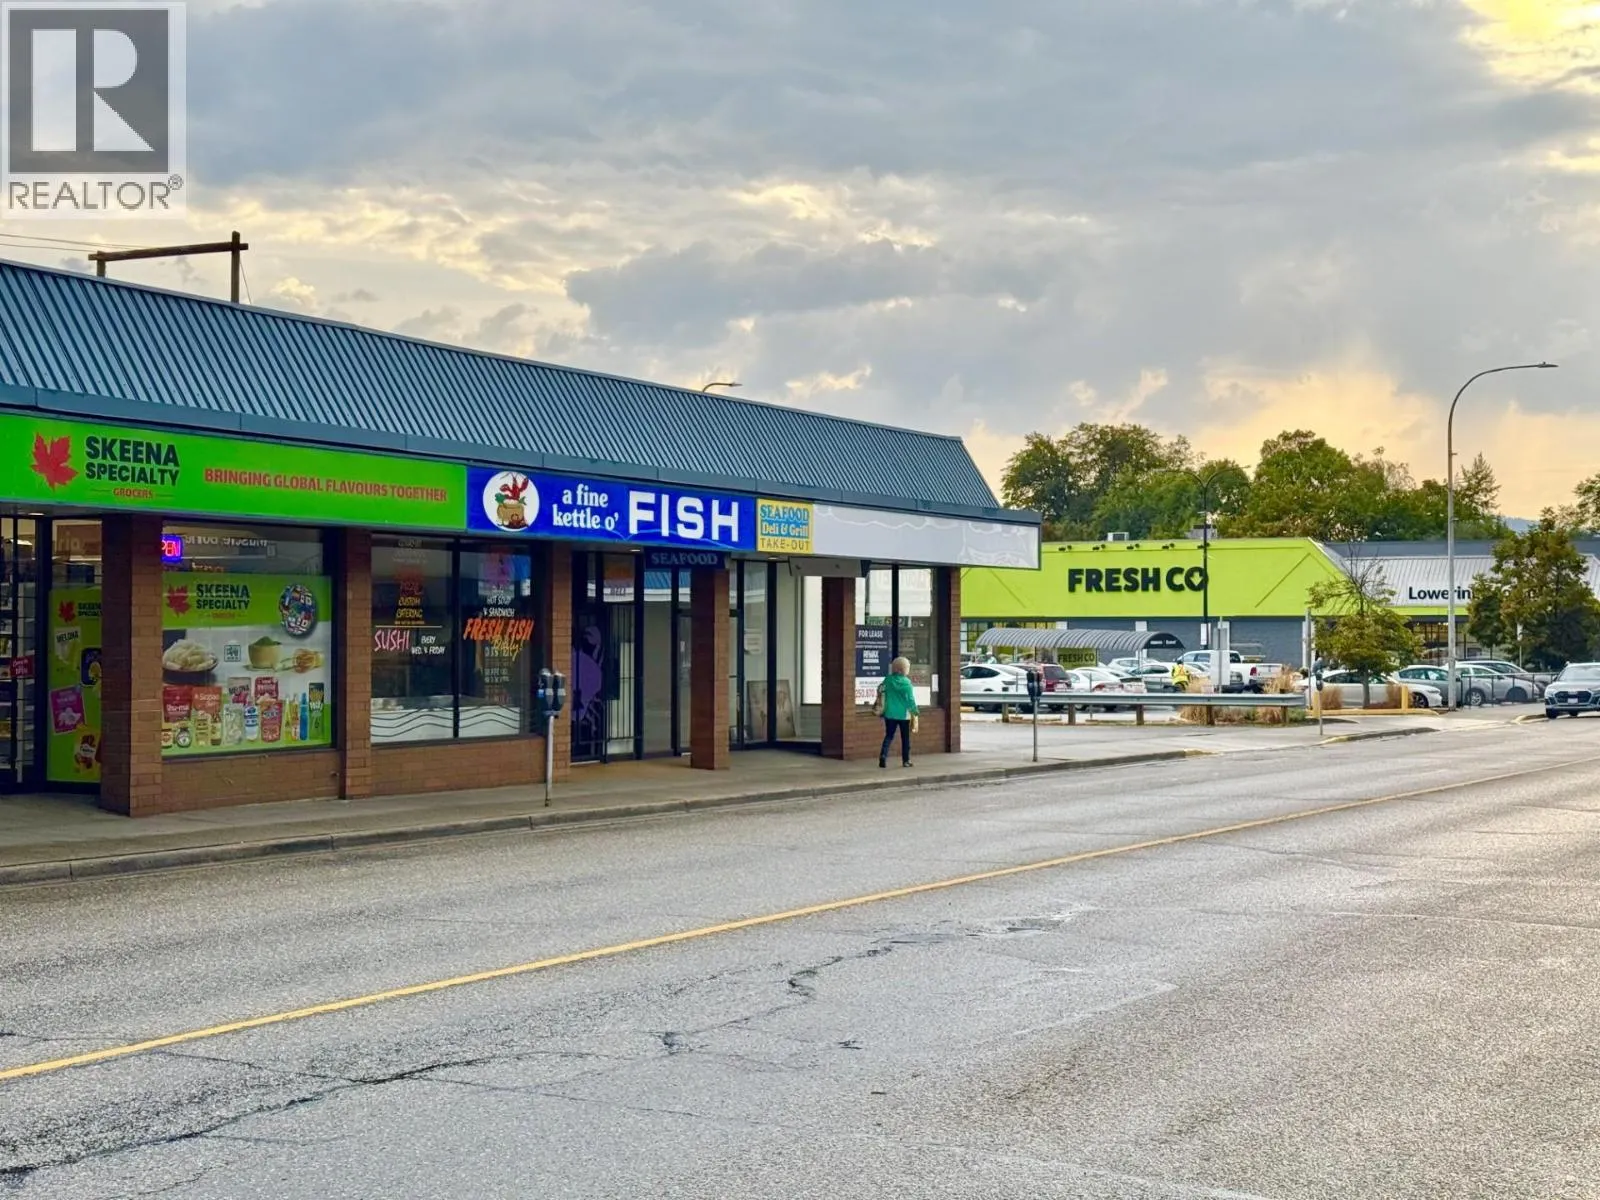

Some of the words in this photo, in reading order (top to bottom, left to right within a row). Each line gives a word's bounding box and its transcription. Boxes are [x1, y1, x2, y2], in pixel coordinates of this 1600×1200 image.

[85, 435, 180, 468] SKEENA
[85, 462, 180, 487] SPECIALTY
[204, 468, 271, 487] BRINGING
[273, 474, 323, 492] GLOBAL
[325, 479, 388, 497] FLAVOURS
[389, 485, 448, 501] TOGETHER
[562, 489, 573, 504] a
[576, 483, 609, 508] fine
[552, 504, 601, 529] kettle
[629, 490, 739, 542] FISH
[760, 504, 810, 522] SEAFOOD
[761, 522, 779, 535] Deli
[780, 523, 788, 535] &
[788, 524, 810, 537] Grill
[760, 538, 810, 550] TAKE-OUT
[651, 552, 718, 565] SEAFOOD
[1068, 567, 1161, 592] FRESH
[1166, 566, 1209, 592] CO
[196, 583, 250, 599] SKEENA
[1408, 586, 1472, 600] Lowerin
[196, 599, 250, 610] SPECIALTY
[463, 618, 504, 640] FRESH
[505, 619, 534, 640] FISH
[858, 630, 868, 638] FOR
[869, 630, 883, 638] LEASE
[374, 629, 410, 652] SUSHI
[421, 635, 436, 644] EVERY
[1058, 653, 1083, 663] FRESH
[1084, 653, 1095, 662] CO
